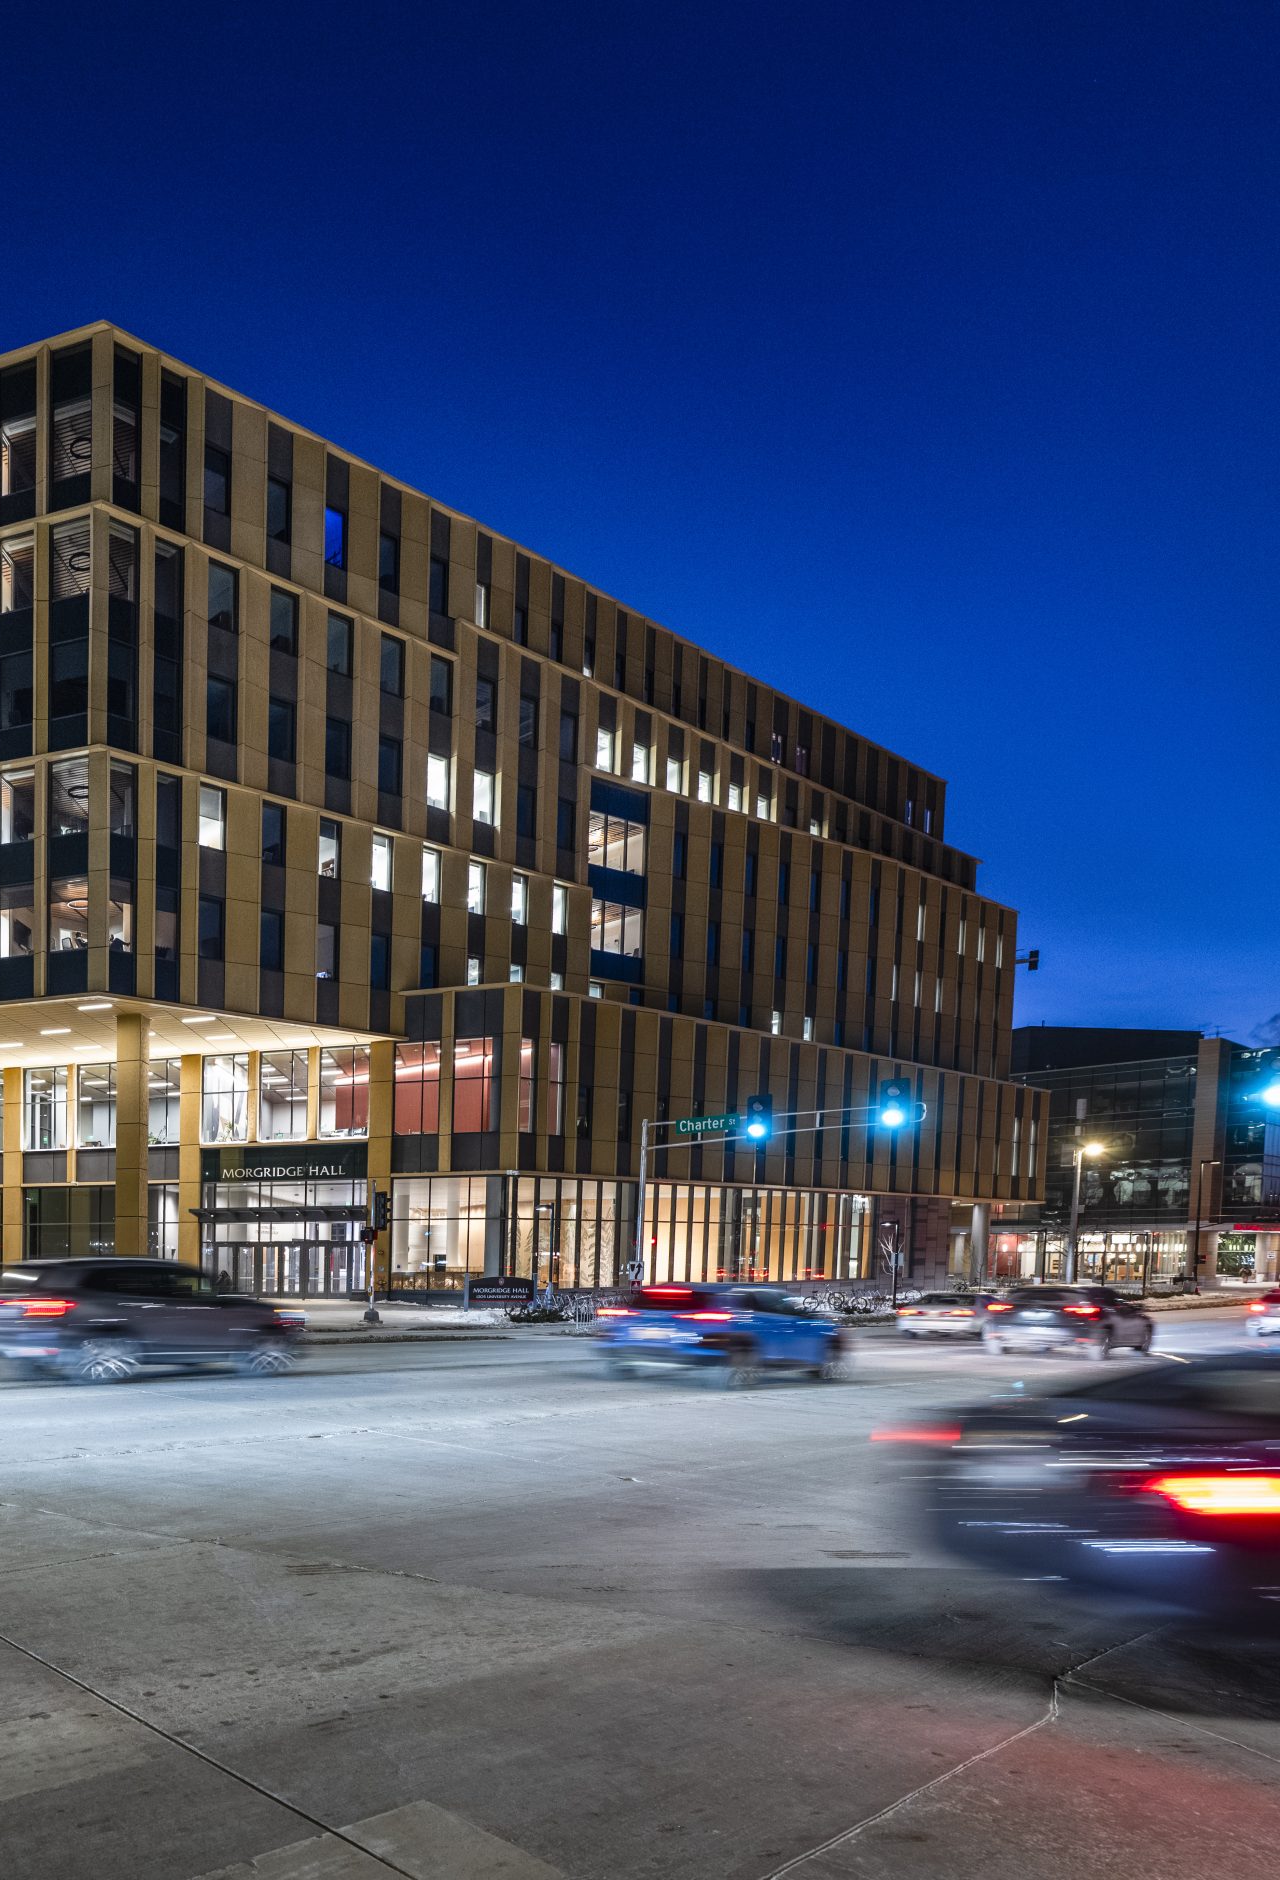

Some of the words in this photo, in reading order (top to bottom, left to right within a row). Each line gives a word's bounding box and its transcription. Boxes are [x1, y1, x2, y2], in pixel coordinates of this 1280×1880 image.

[679, 1118, 725, 1132] Charter
[222, 1167, 304, 1179] MORGRIDGE
[308, 1165, 346, 1176] HALL
